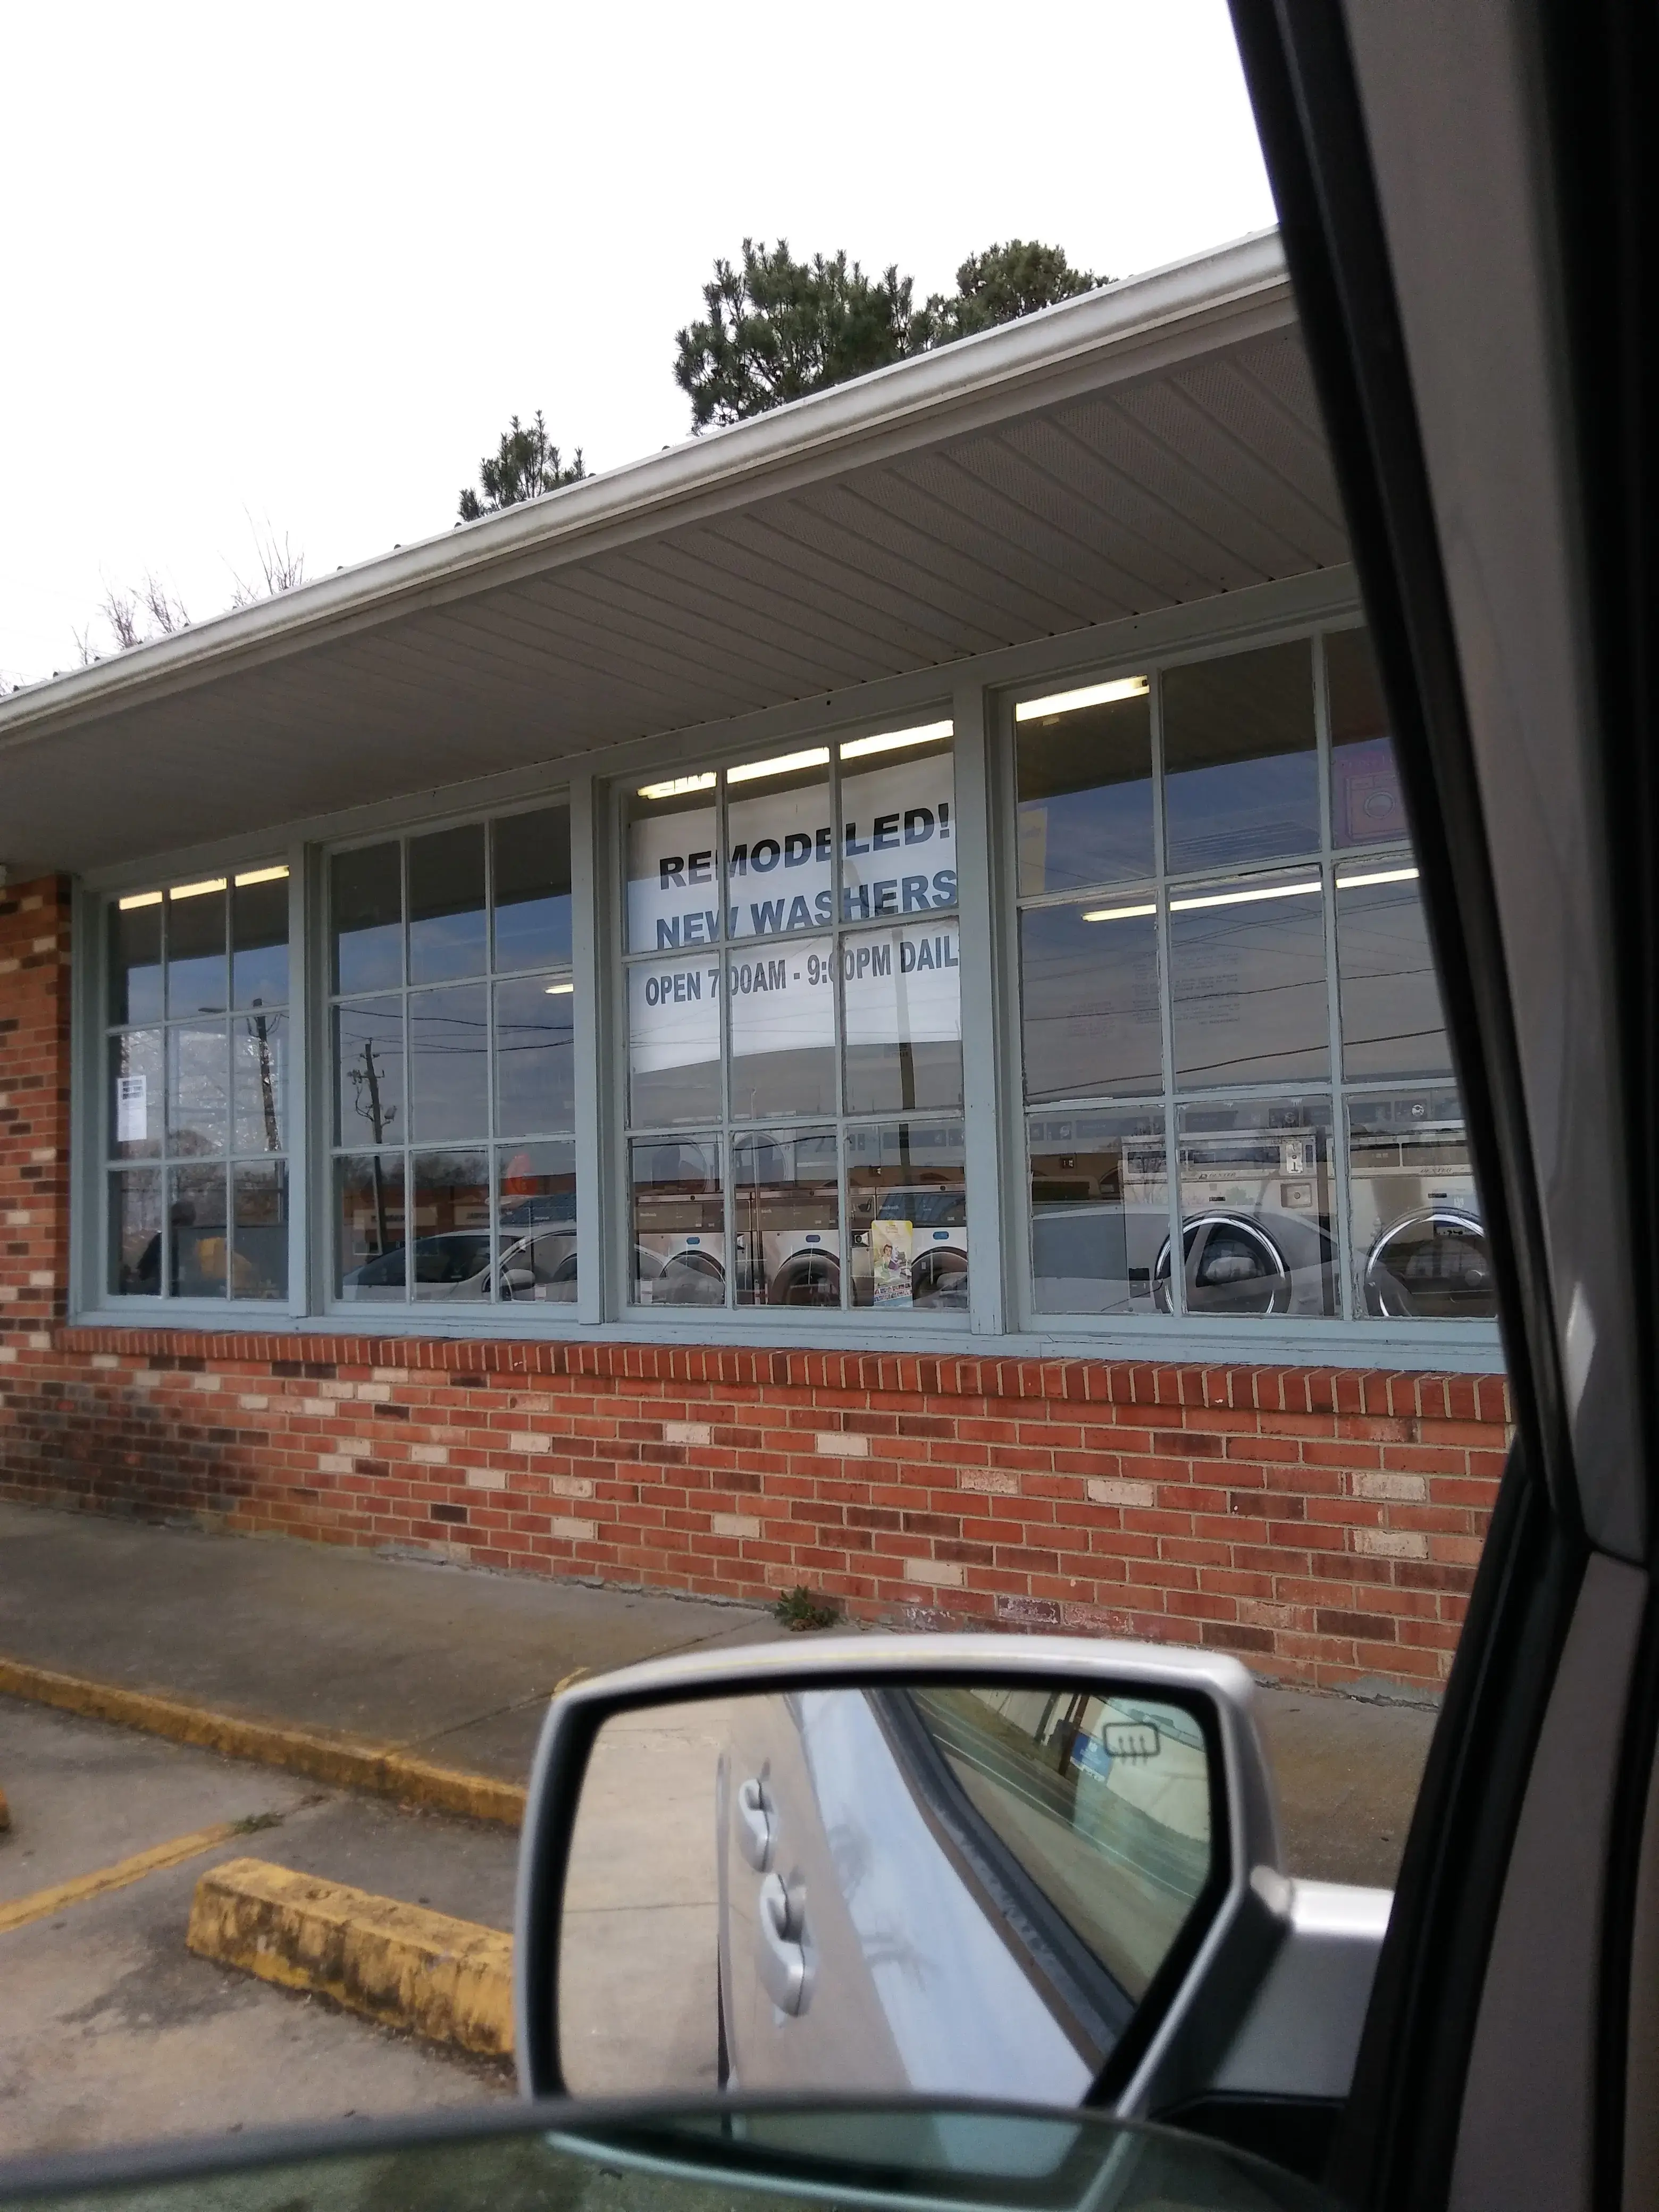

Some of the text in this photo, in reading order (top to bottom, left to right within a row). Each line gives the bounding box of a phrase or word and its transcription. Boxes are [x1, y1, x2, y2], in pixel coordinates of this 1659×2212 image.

[659, 803, 950, 890] REMODELED!
[657, 870, 958, 950] NEW WASHERS
[646, 971, 700, 1006] OPEN
[707, 959, 786, 998] 700AM
